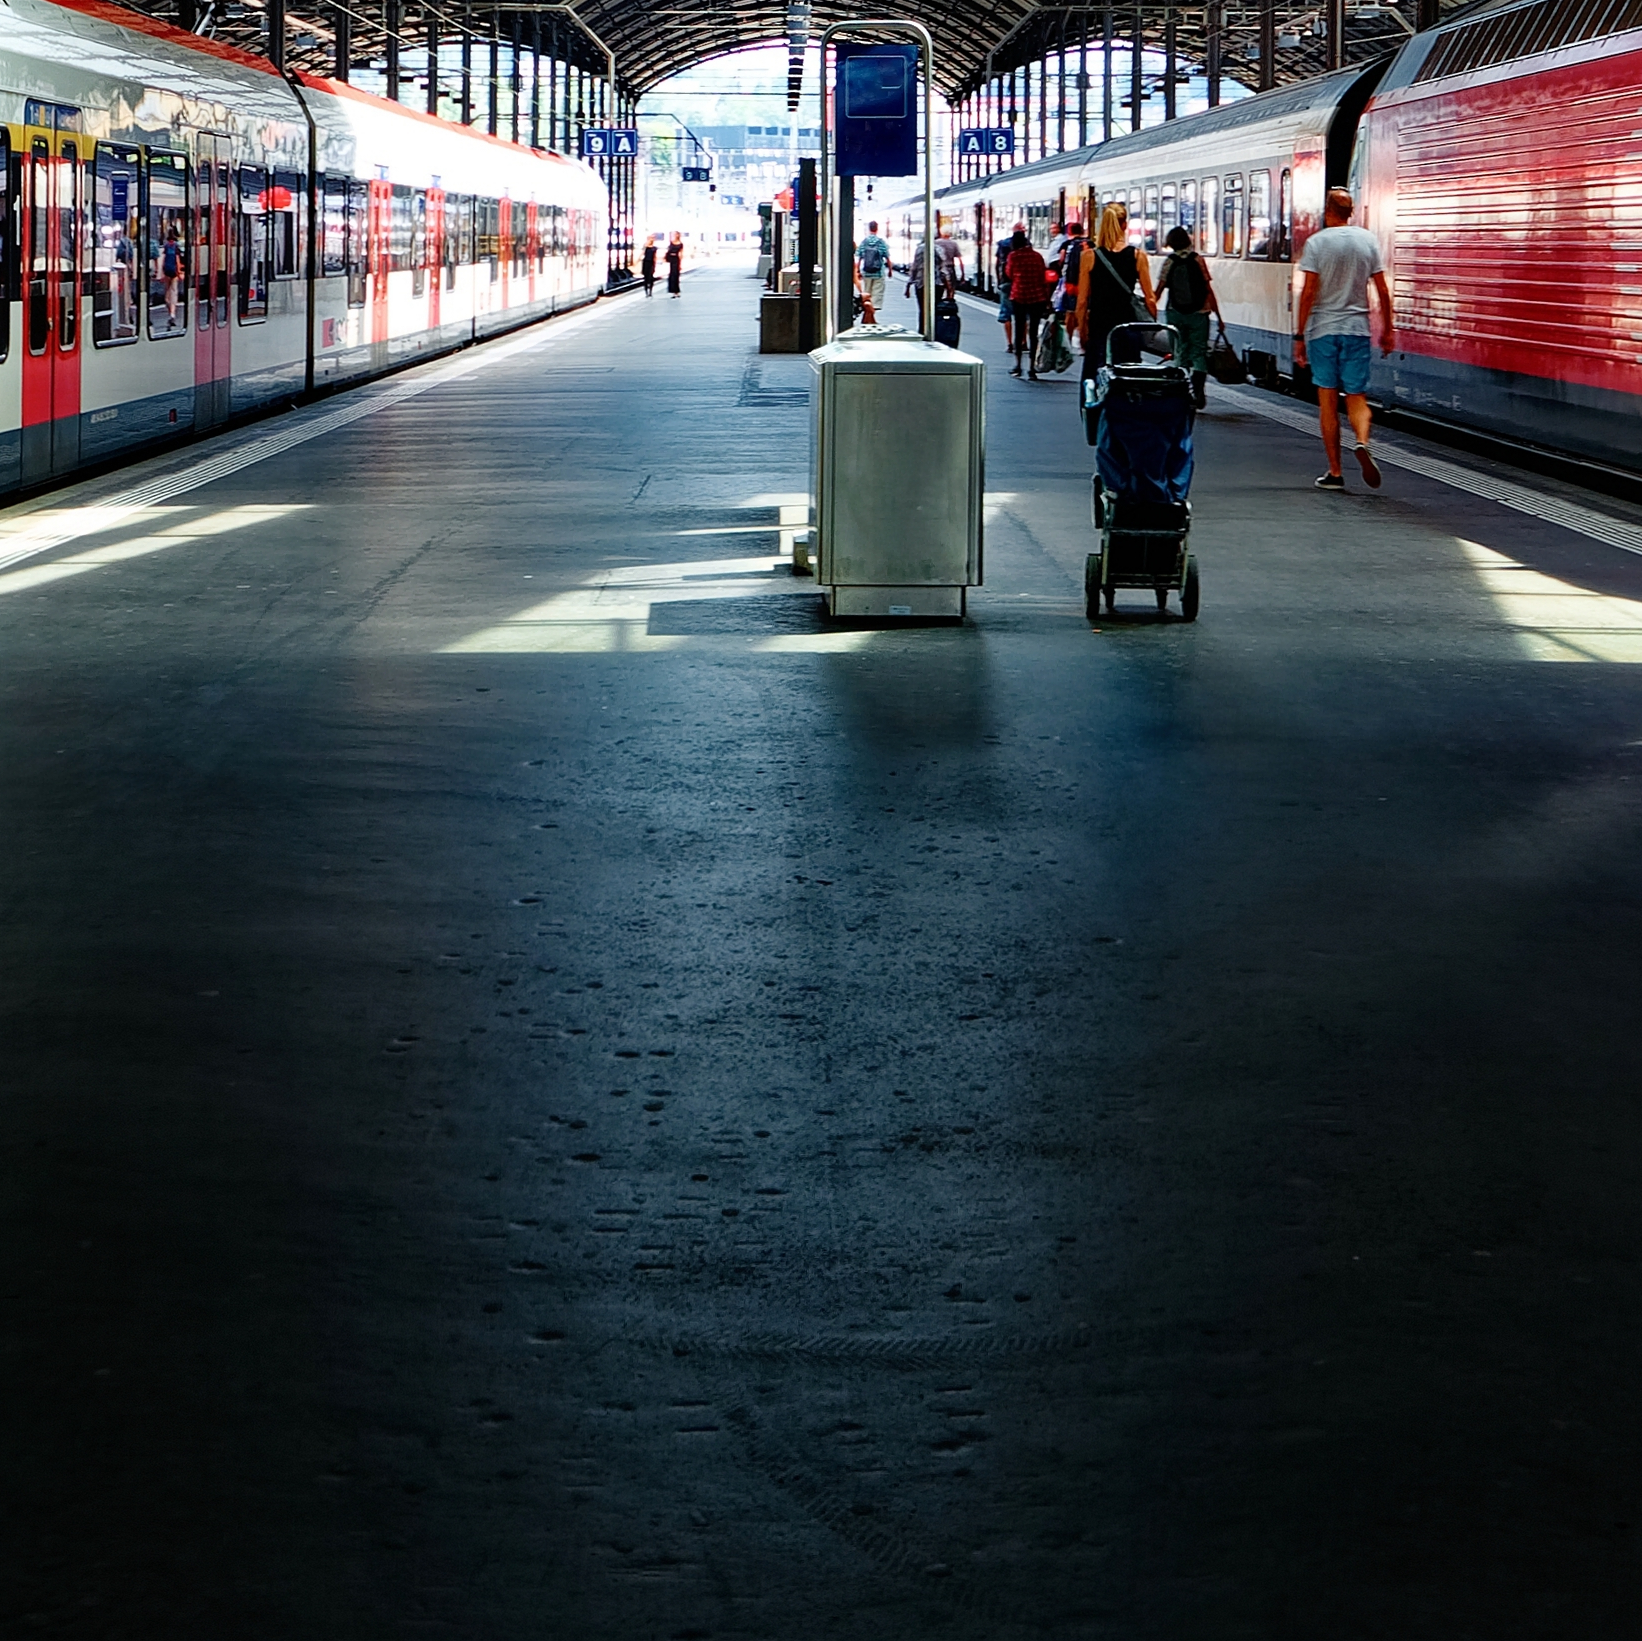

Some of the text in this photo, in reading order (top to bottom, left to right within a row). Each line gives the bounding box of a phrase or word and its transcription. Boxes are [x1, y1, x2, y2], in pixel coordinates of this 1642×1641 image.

[590, 137, 632, 152] 9 A
[967, 135, 1008, 151] A 8
[685, 171, 693, 180] 9
